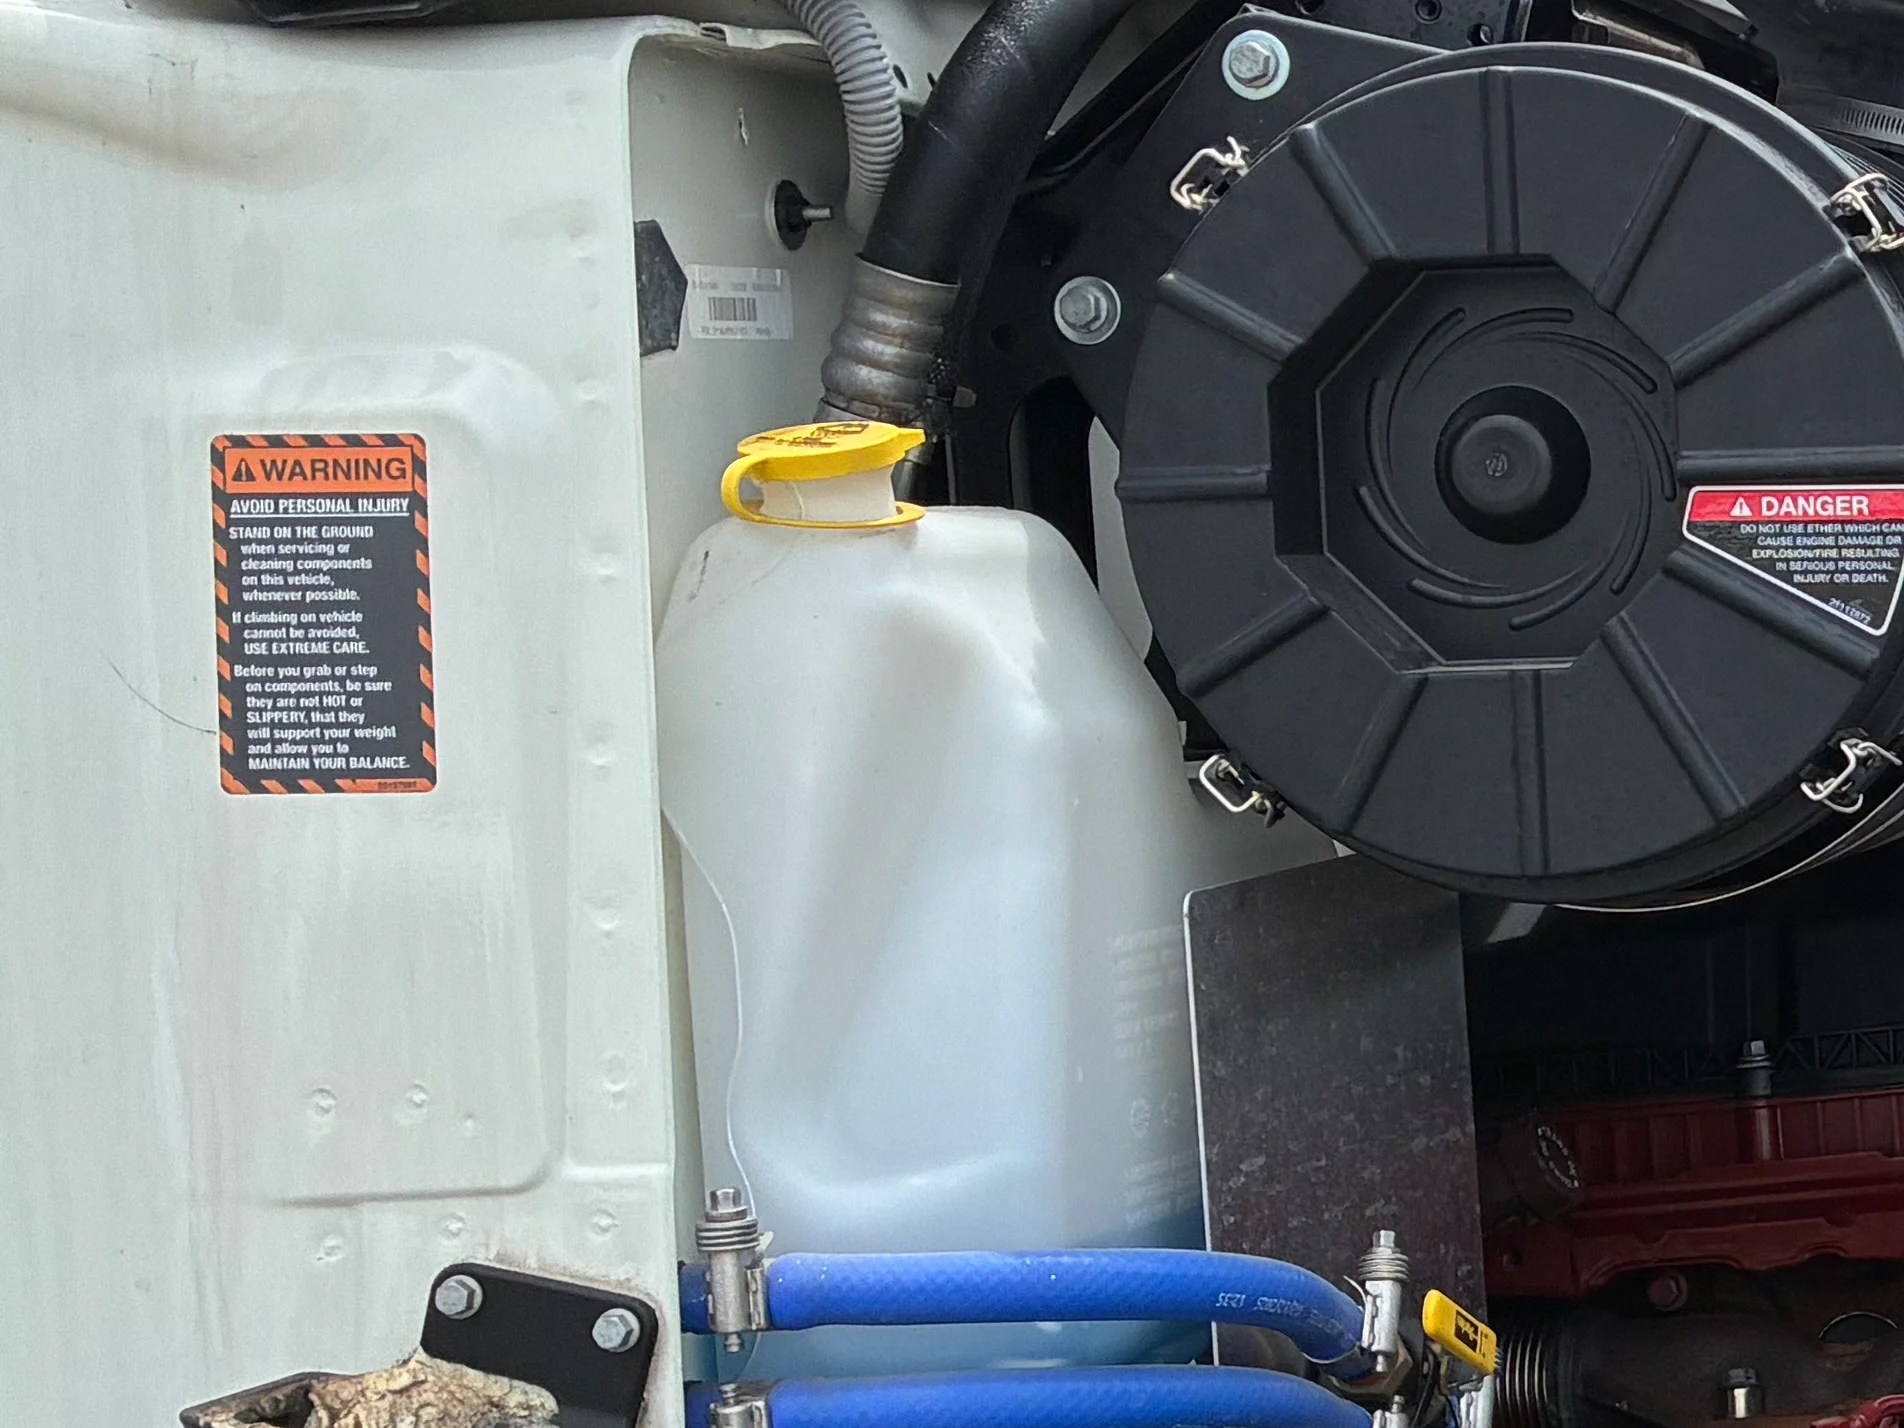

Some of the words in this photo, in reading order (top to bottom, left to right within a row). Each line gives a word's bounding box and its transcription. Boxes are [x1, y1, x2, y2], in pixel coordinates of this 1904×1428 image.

[259, 457, 406, 482] WARNING
[230, 499, 274, 515] AVOID
[279, 498, 354, 514] PERSONAL
[358, 498, 409, 514] INJURY
[1761, 496, 1869, 516] DANGER
[229, 526, 270, 539] STAND
[295, 526, 318, 538] THE
[322, 526, 373, 538] GROUND
[244, 642, 269, 655] USE
[272, 641, 330, 654] EXTREME
[333, 641, 370, 654] CARE.
[248, 757, 310, 770] MAINTAIN
[313, 757, 346, 769] YOUR
